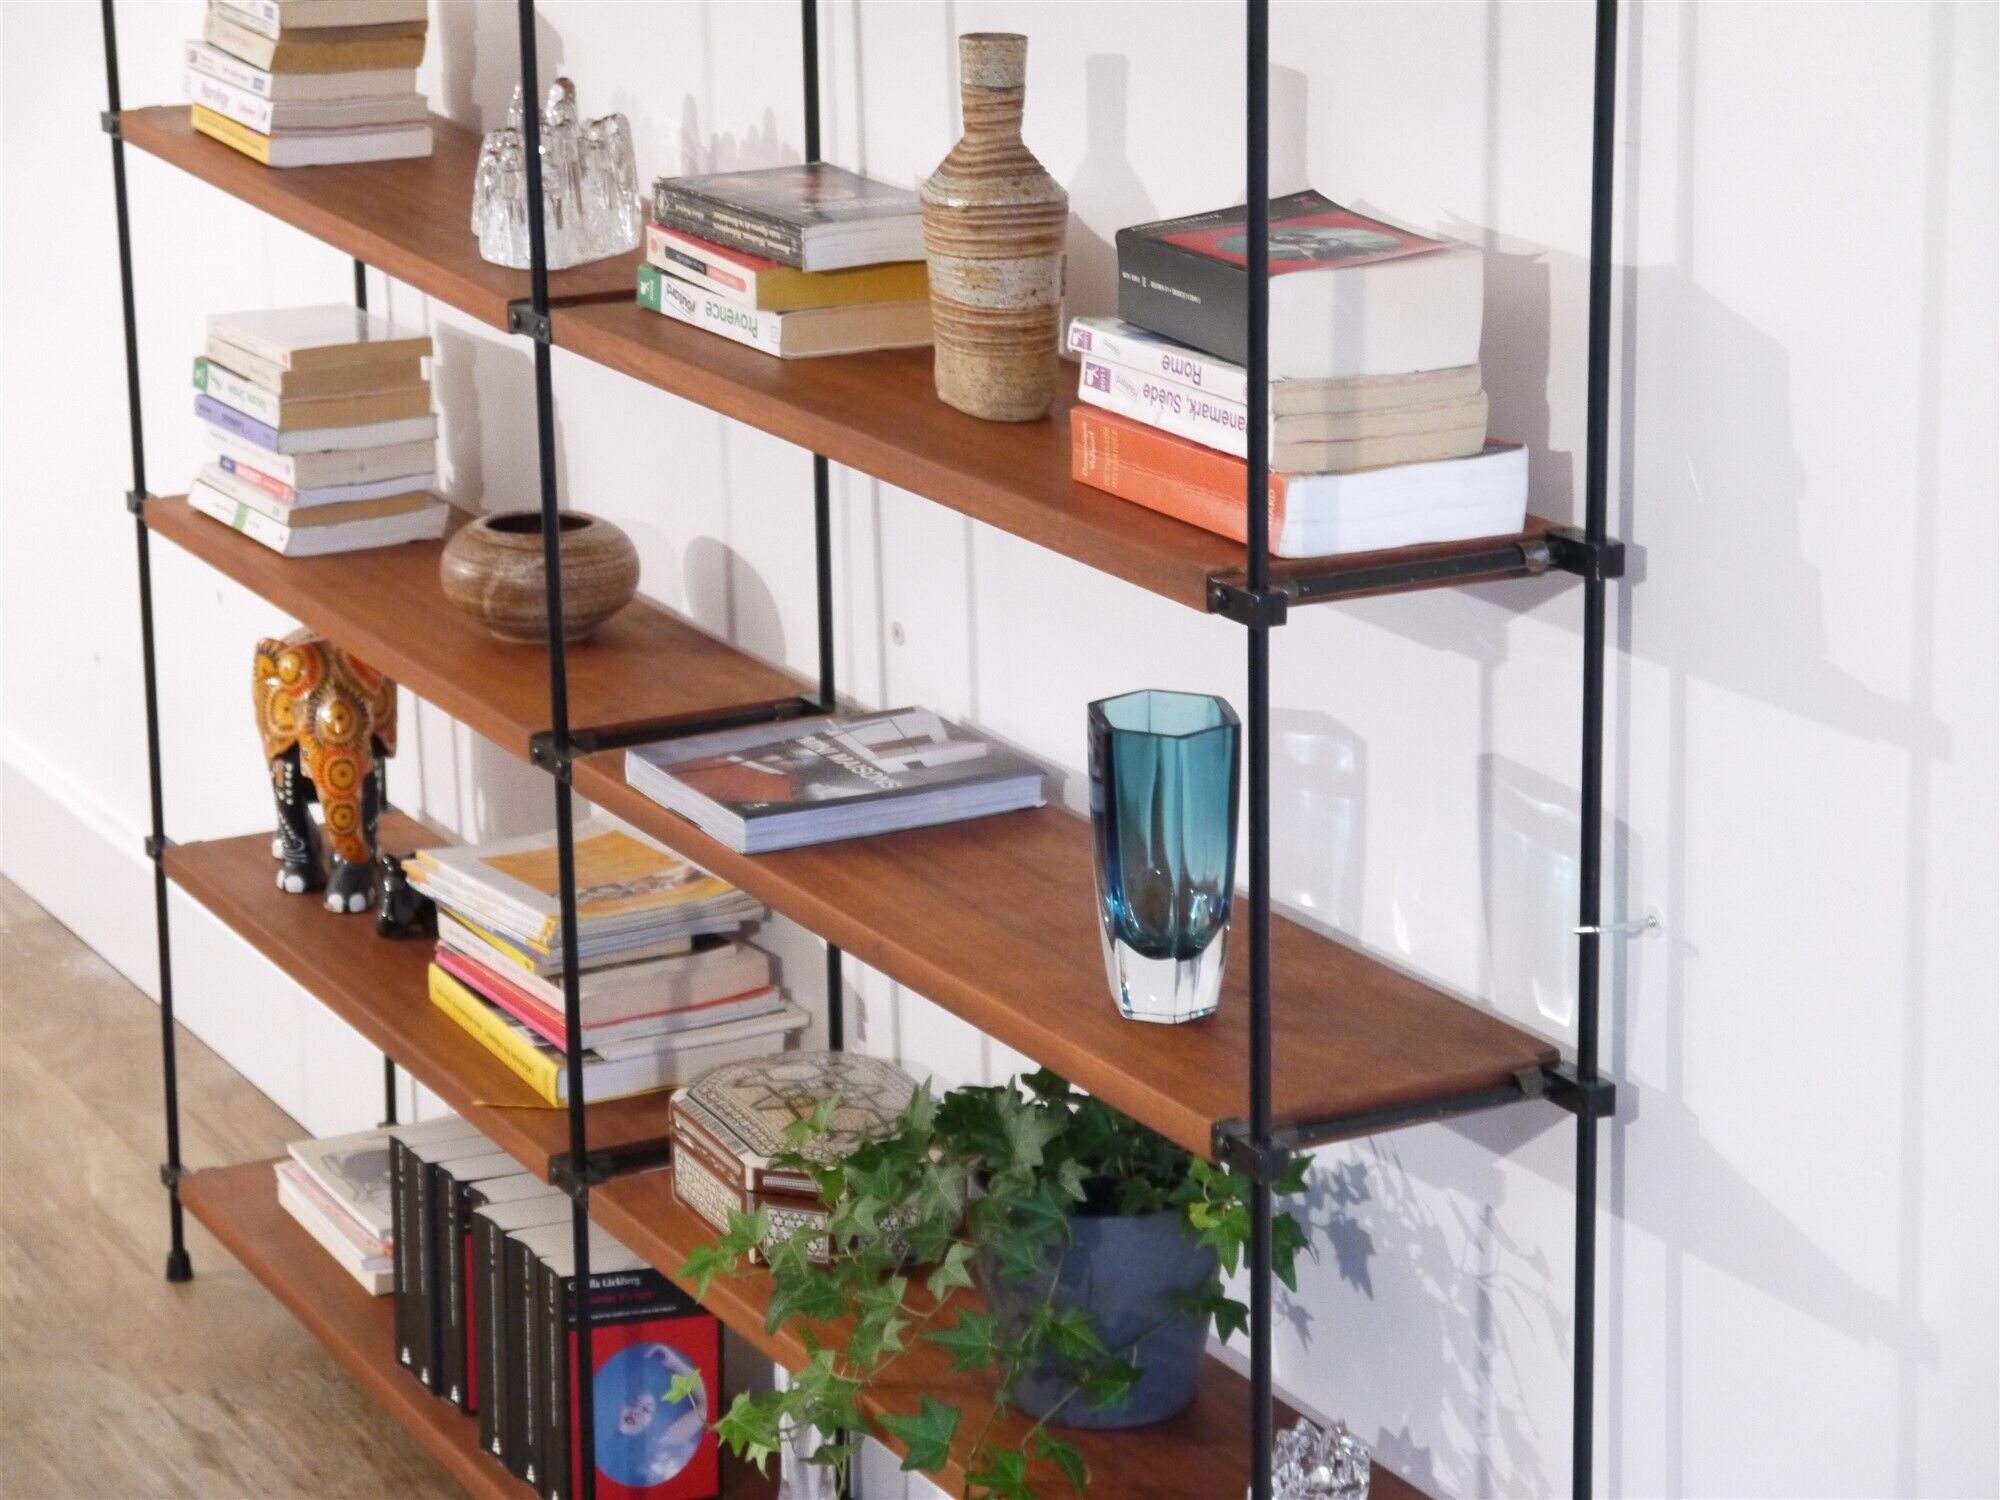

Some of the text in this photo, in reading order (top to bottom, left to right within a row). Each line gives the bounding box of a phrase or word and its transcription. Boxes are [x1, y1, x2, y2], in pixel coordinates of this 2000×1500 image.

[704, 300, 758, 339] Provence
[1162, 354, 1202, 386] Rome
[1143, 383, 1182, 414] Suède
[1187, 397, 1248, 433] anemark,
[825, 753, 903, 789] MAISONS
